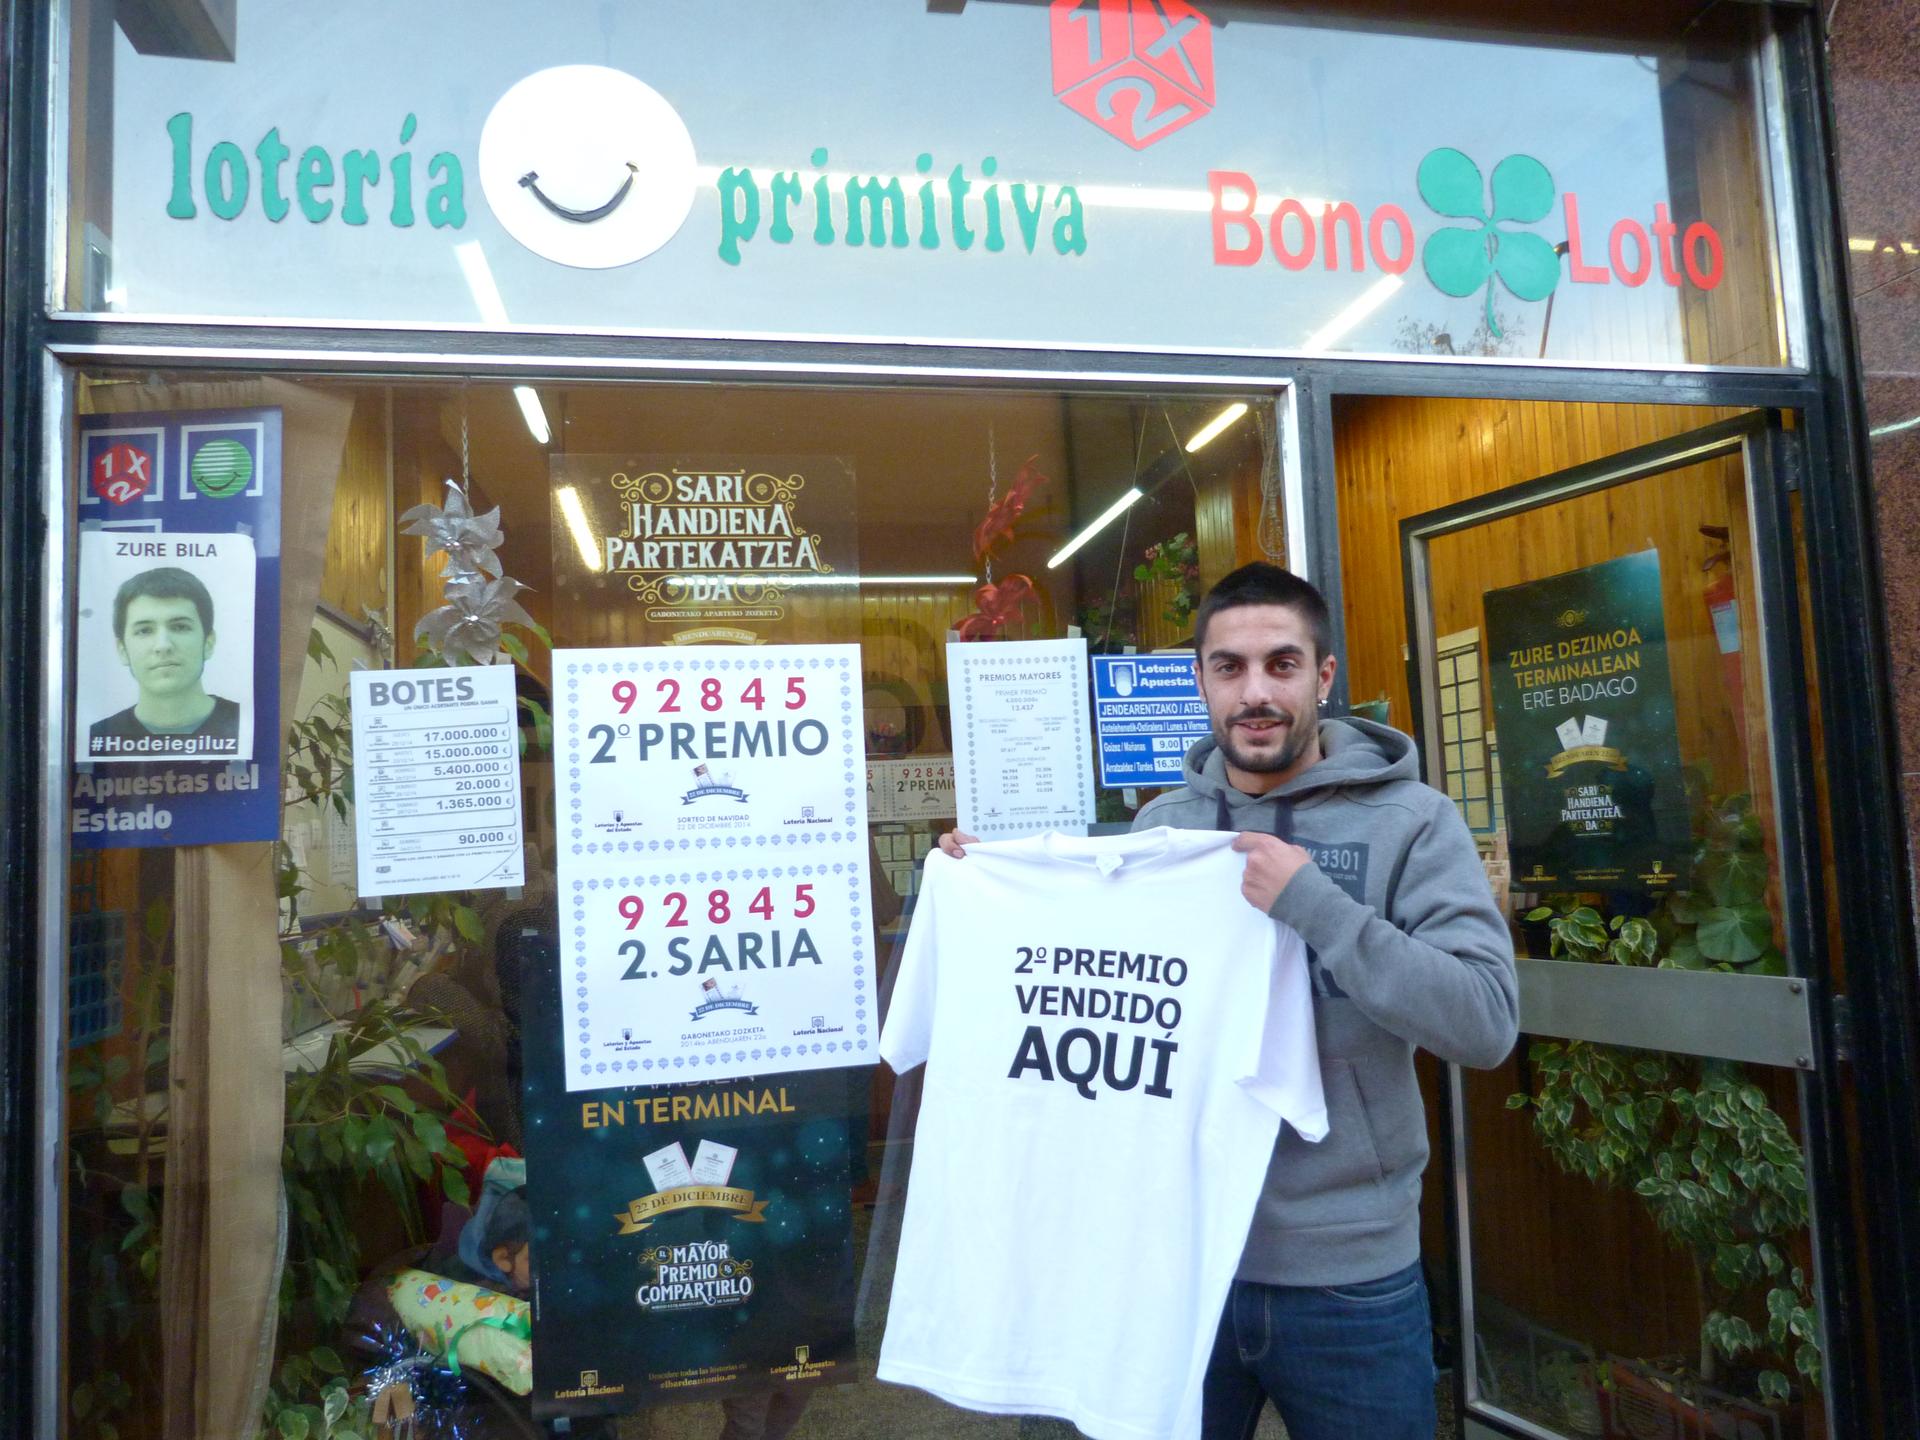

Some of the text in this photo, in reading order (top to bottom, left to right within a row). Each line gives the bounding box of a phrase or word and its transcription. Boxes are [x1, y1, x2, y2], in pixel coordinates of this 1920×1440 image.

[166, 112, 467, 230] lotería
[717, 147, 1087, 265] primitiva
[1207, 170, 1415, 273] Bono
[1564, 192, 1723, 291] Loto
[676, 475, 743, 502] SARI
[631, 503, 793, 539] HANDIENA
[116, 542, 217, 558] ZURE BILA
[605, 537, 820, 573] PARTEKATZEA
[692, 575, 733, 601] DA
[1509, 627, 1642, 669] ZURE DEZIMOA
[1019, 672, 1062, 680] MAYORES
[1140, 678, 1194, 688] Apuestas
[1514, 651, 1641, 689] TERMINALEAN
[369, 676, 475, 707] BOTES
[1522, 676, 1637, 710] ERE BADAGO
[1102, 703, 1178, 716] JENDEARENTZAKO
[91, 735, 237, 754] #Hodeiegiluz
[424, 728, 498, 742] 17.000.000
[639, 718, 829, 761] PREMIO
[425, 745, 499, 760] 15.000.000
[434, 762, 500, 776] 5.400.000
[73, 763, 259, 803] Apuestas del
[456, 779, 501, 791] 20.000
[1577, 785, 1597, 796] SARI
[436, 796, 501, 810] 1.365.000
[72, 804, 172, 832] Estado
[718, 814, 750, 822] NAVIDAD
[459, 832, 504, 844] 90.000
[1320, 849, 1359, 871] 3301
[667, 928, 823, 976] SARIA
[1053, 948, 1188, 986] PREMIO
[1015, 984, 1182, 1029] VENDIDO
[681, 1026, 765, 1040] GABONETAKO ZOZKETA
[1007, 1026, 1179, 1100] AQUÍ
[582, 1087, 795, 1129] EN TERMINAL
[635, 1191, 746, 1214] 22 DE DICIEMBRE
[673, 1240, 729, 1264] MAYOR
[659, 1263, 718, 1285] PREMIO
[638, 1276, 752, 1306] COMPARTIRLO
